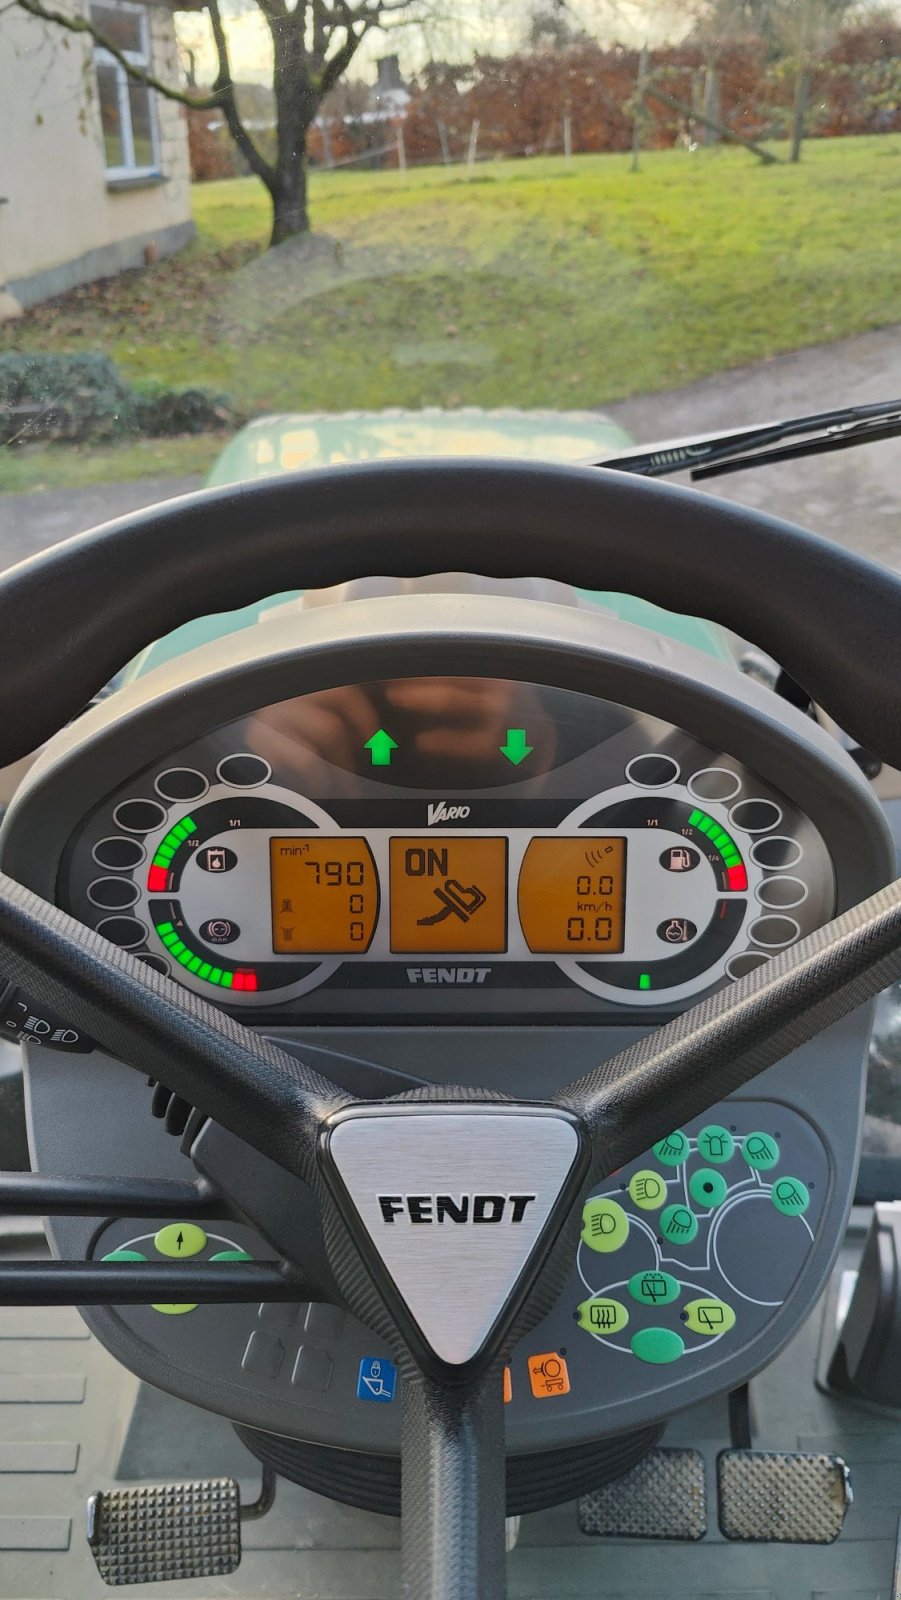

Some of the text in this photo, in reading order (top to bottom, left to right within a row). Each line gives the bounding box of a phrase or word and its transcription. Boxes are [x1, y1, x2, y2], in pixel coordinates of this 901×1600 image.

[229, 819, 241, 827] 1/1
[646, 819, 659, 827] 1/1
[187, 839, 200, 847] 1/2
[405, 848, 448, 877] ON
[305, 861, 364, 886] 790
[576, 875, 614, 896] 0.0
[349, 894, 364, 914] 0
[577, 901, 612, 913] km/h
[349, 922, 364, 941] 0
[567, 917, 612, 941] 0.0
[406, 967, 493, 984] FENDT
[377, 1194, 537, 1224] FENDT
